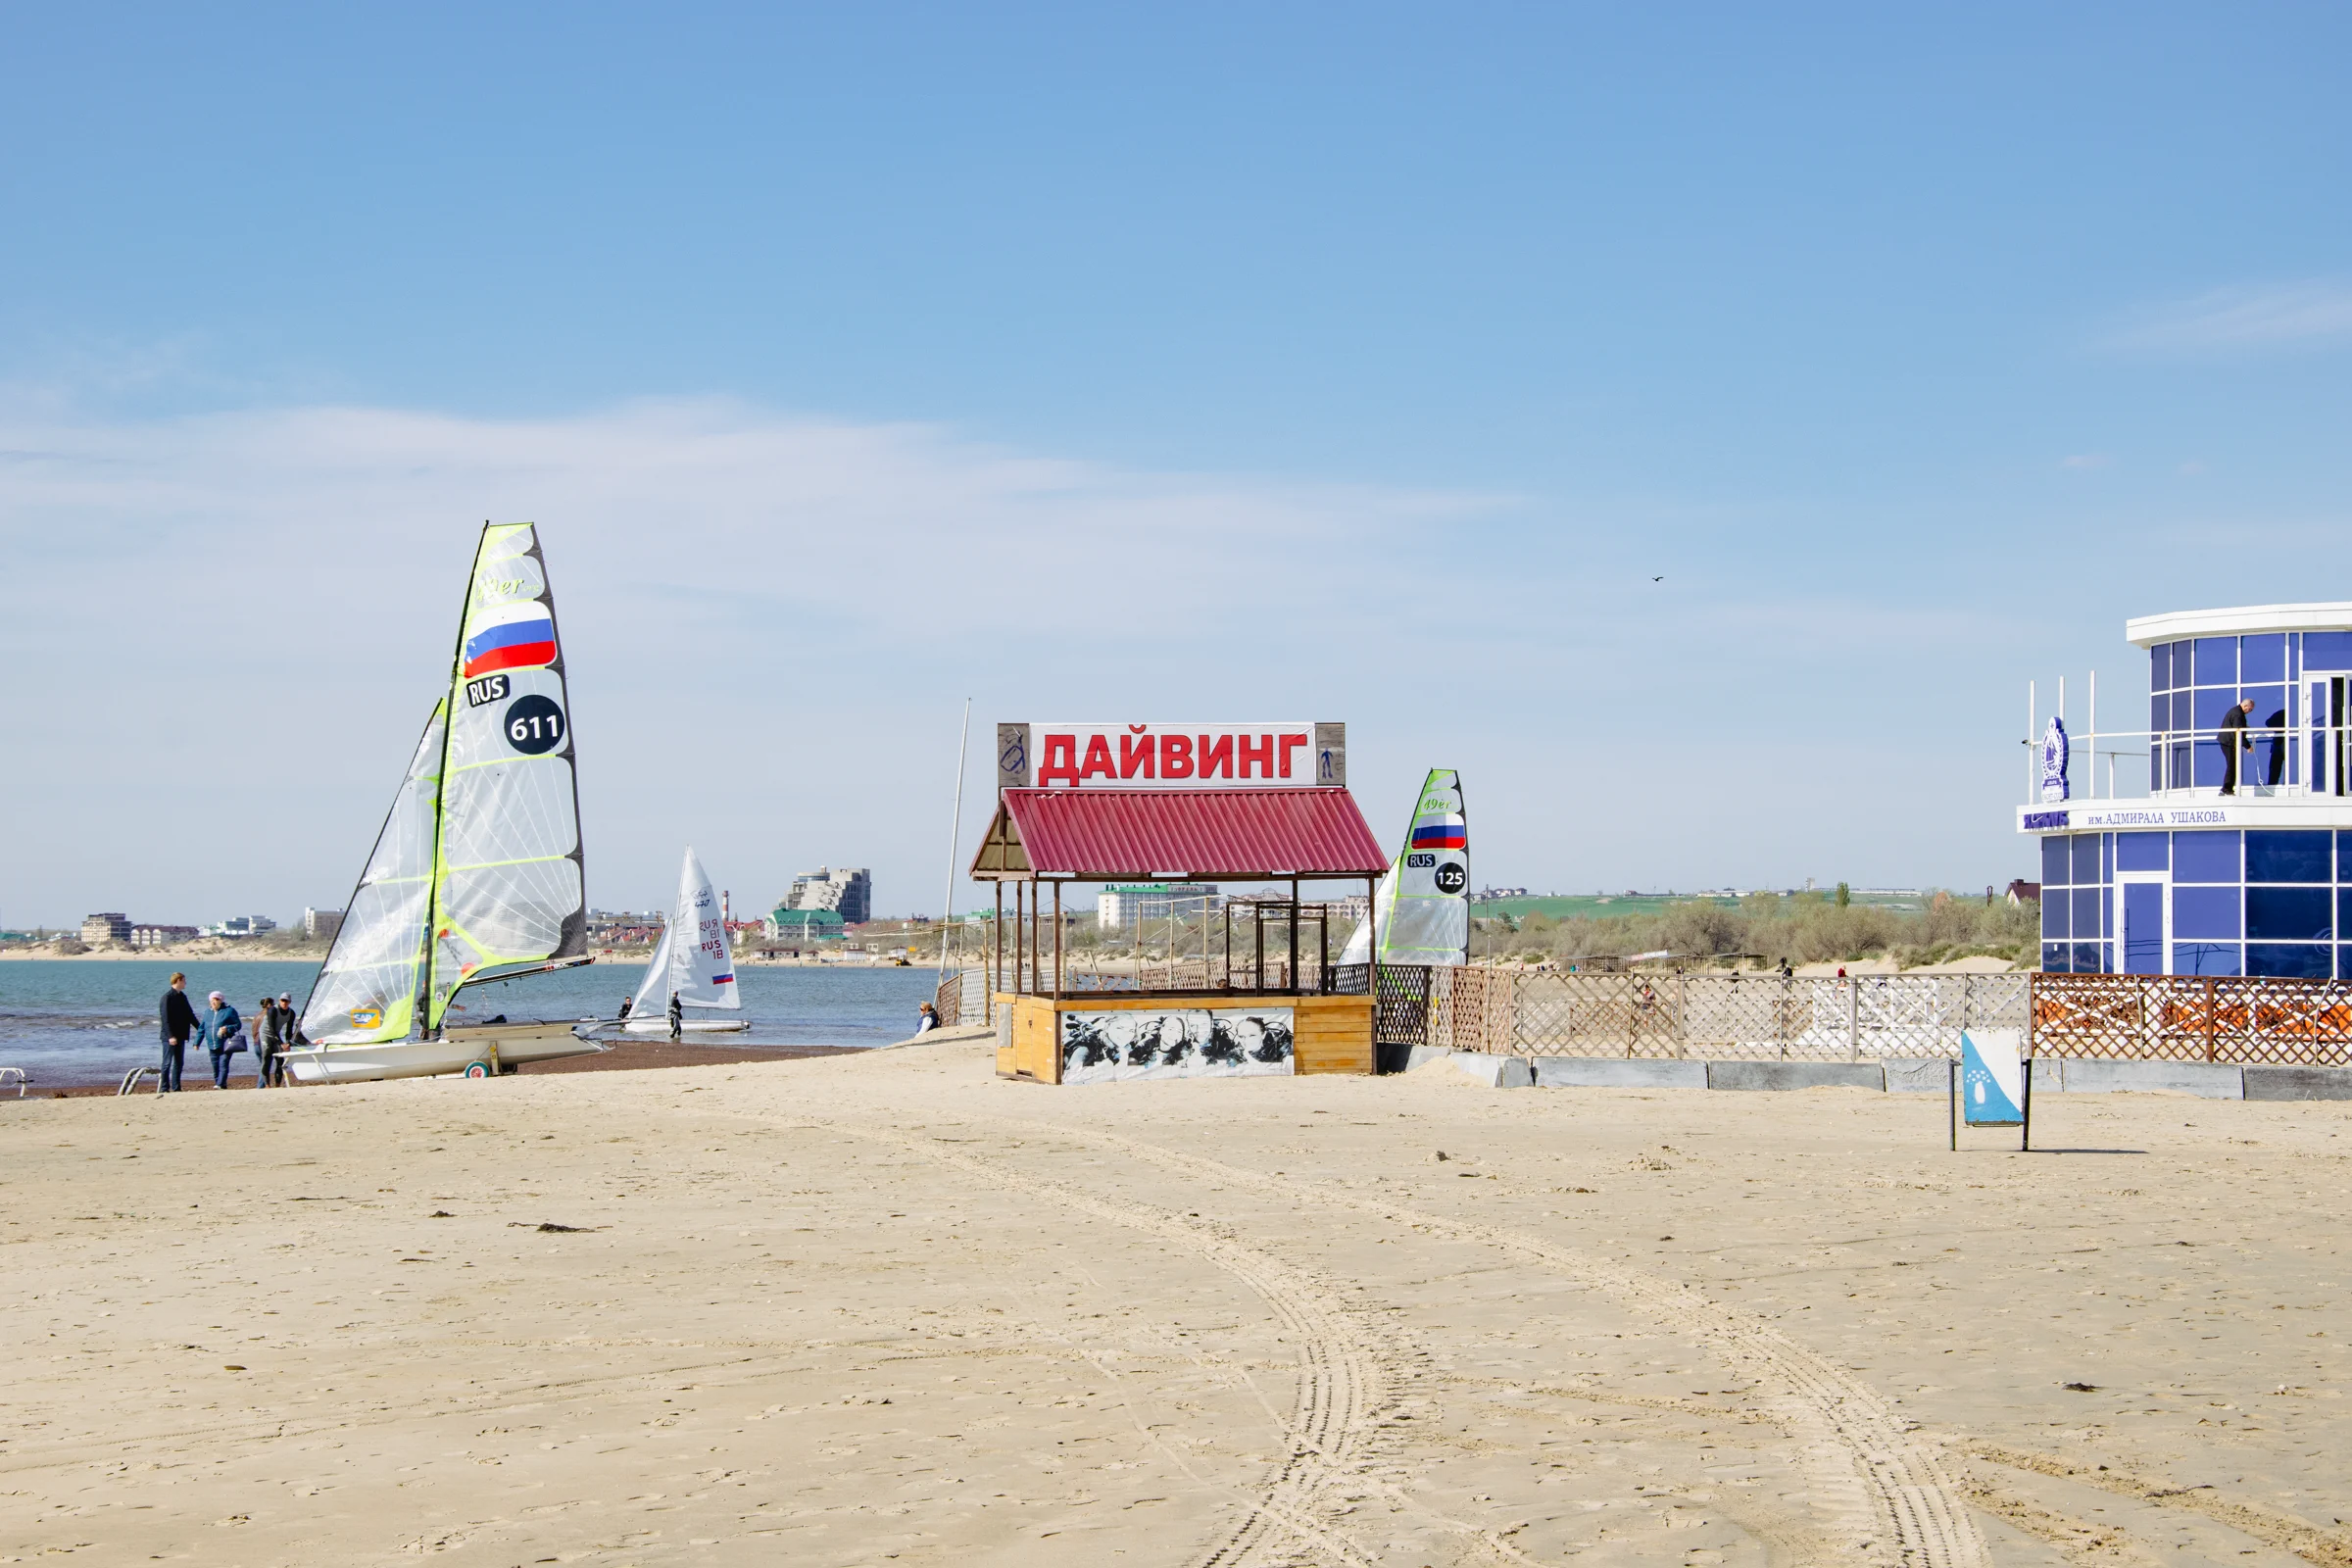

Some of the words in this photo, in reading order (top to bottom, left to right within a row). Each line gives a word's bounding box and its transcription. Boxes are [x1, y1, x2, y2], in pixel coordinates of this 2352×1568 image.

[468, 676, 504, 705] RUS
[511, 714, 558, 741] 611
[1038, 723, 1307, 788] ДАЙВИНГ
[1423, 798, 1451, 810] 49er
[2171, 810, 2227, 823] УШАКОВА
[1409, 855, 1433, 867] RUS
[1438, 872, 1463, 885] 125
[702, 940, 720, 952] RUS
[354, 1013, 372, 1022] SAP
